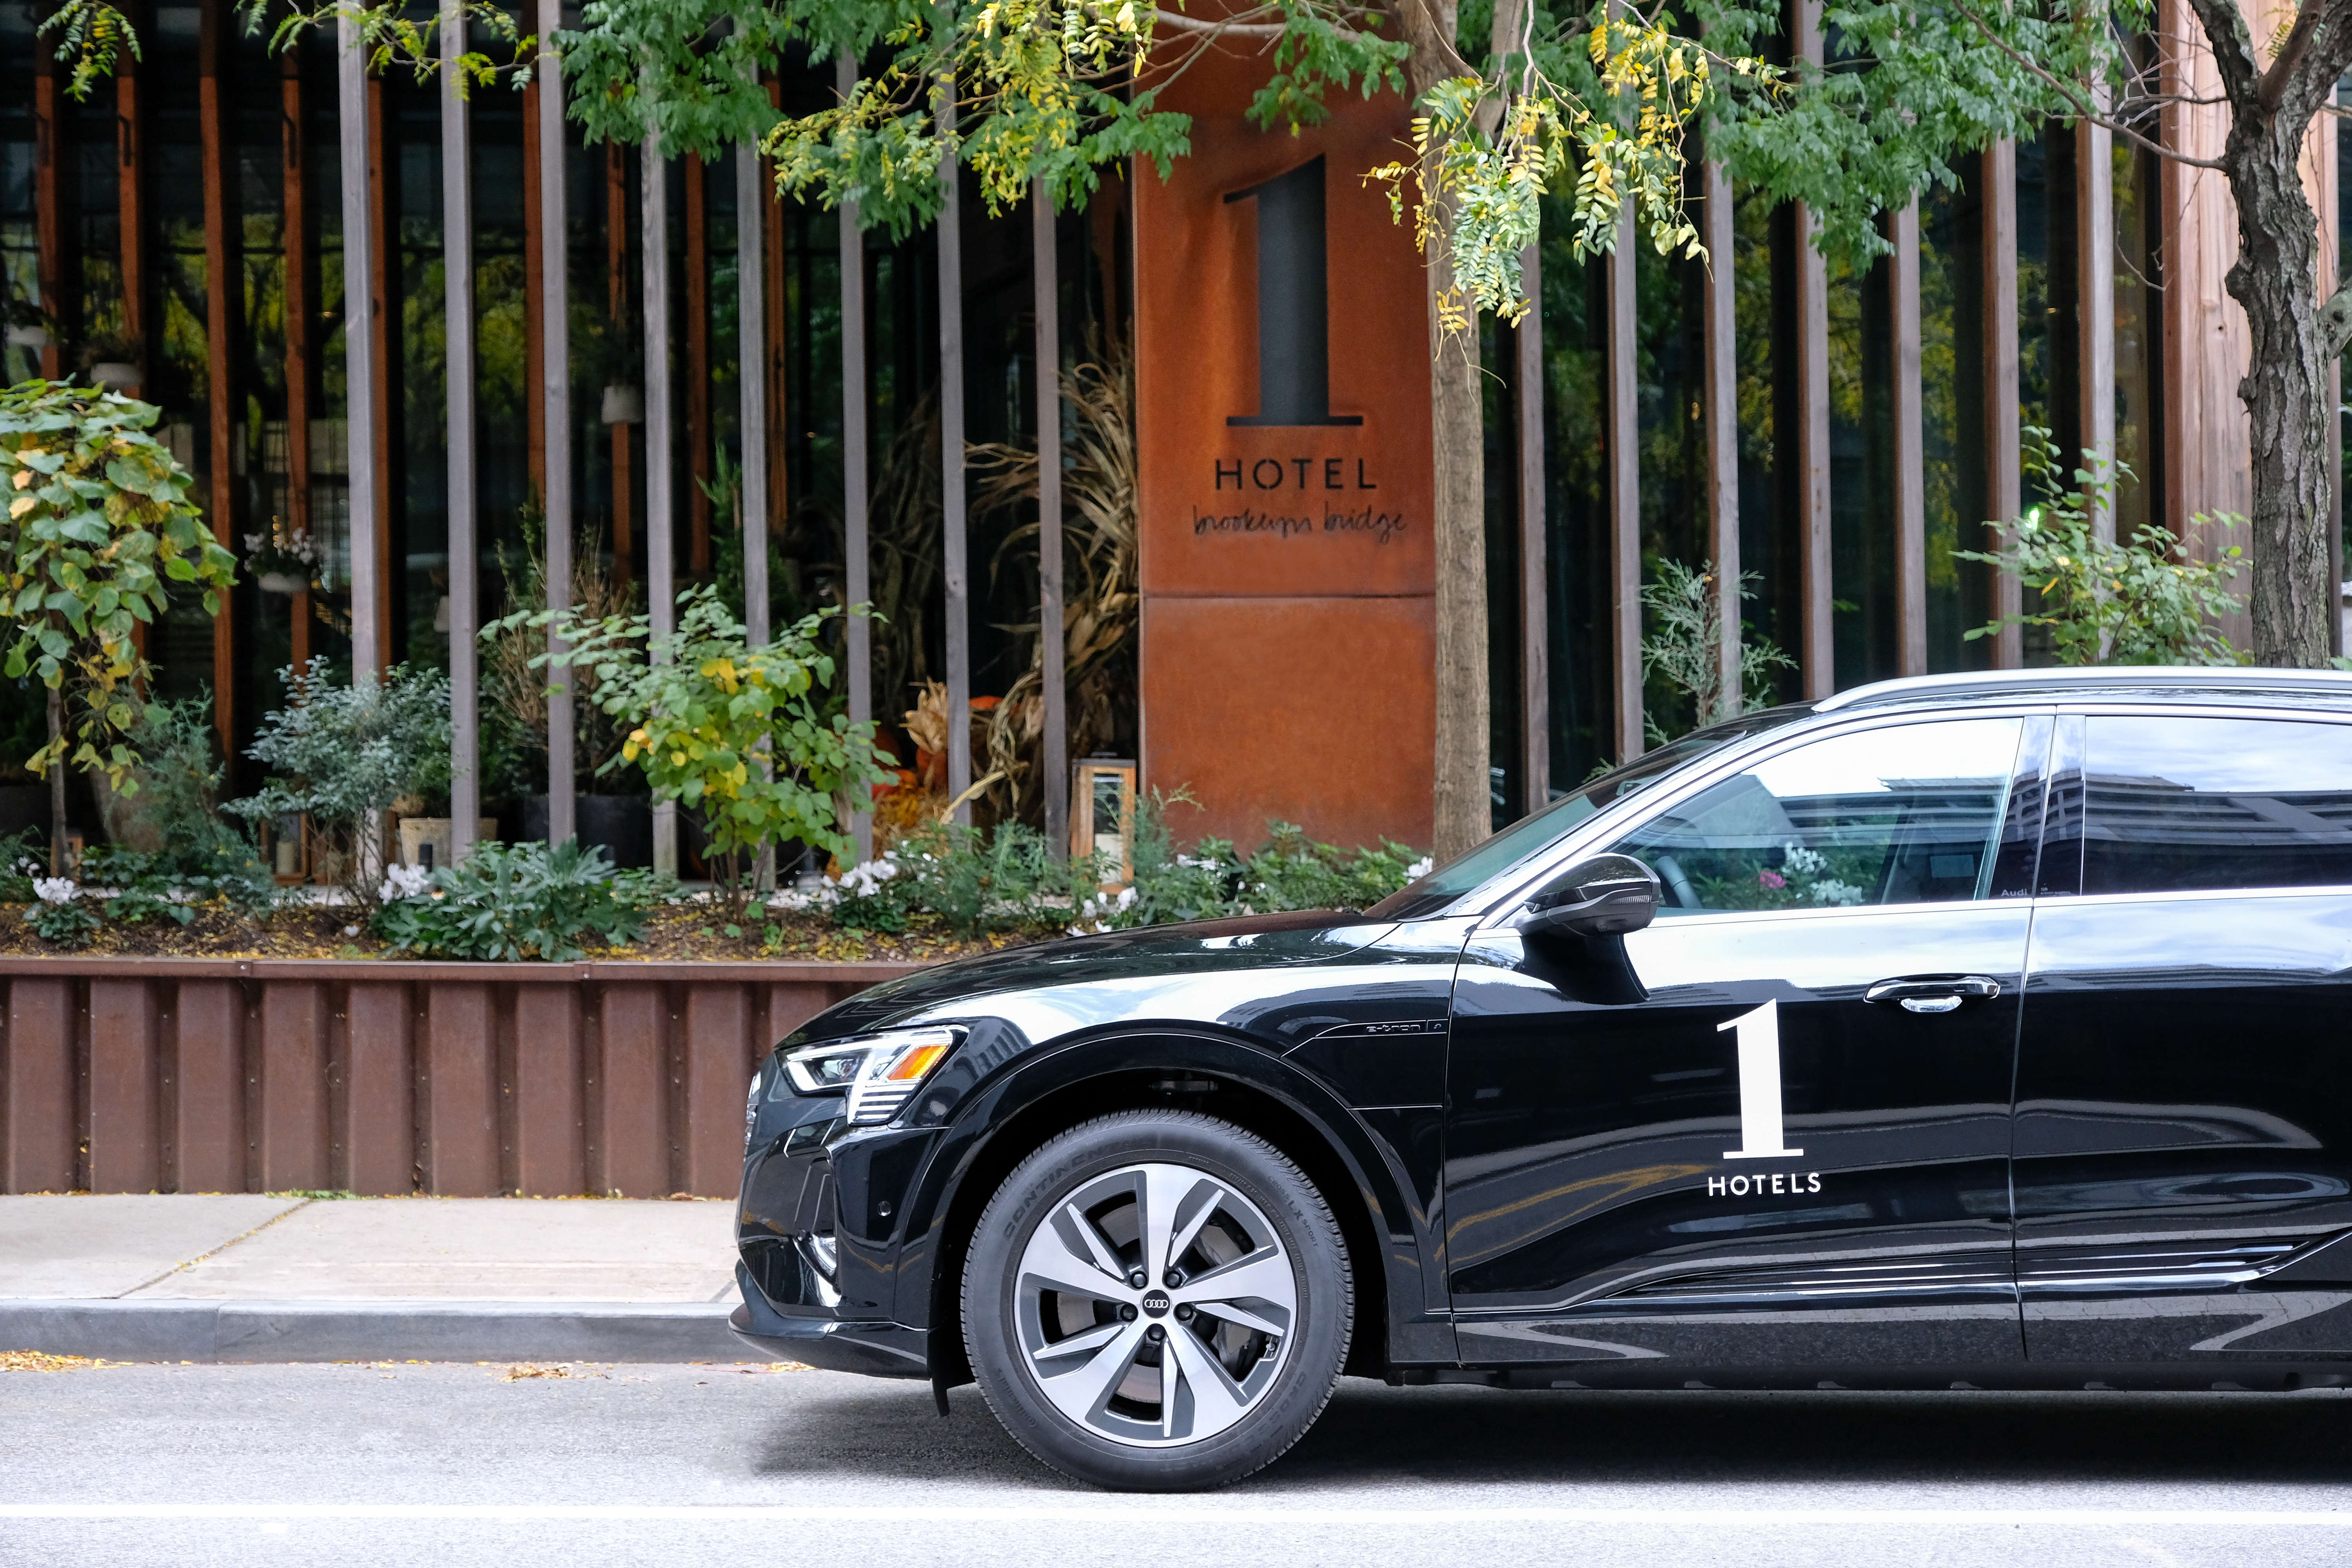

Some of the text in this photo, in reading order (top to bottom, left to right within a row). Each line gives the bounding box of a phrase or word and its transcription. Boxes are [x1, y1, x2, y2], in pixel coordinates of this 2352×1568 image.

[1223, 152, 1363, 426] 1
[1216, 458, 1376, 490] HOTEL
[1324, 502, 1408, 544] bridge
[2001, 889, 2027, 897] Audi
[1717, 998, 1804, 1159] 1
[1708, 1172, 1821, 1196] HOTELS
[1267, 1176, 1290, 1199] CROSS
[1301, 1219, 1318, 1248] SPORT
